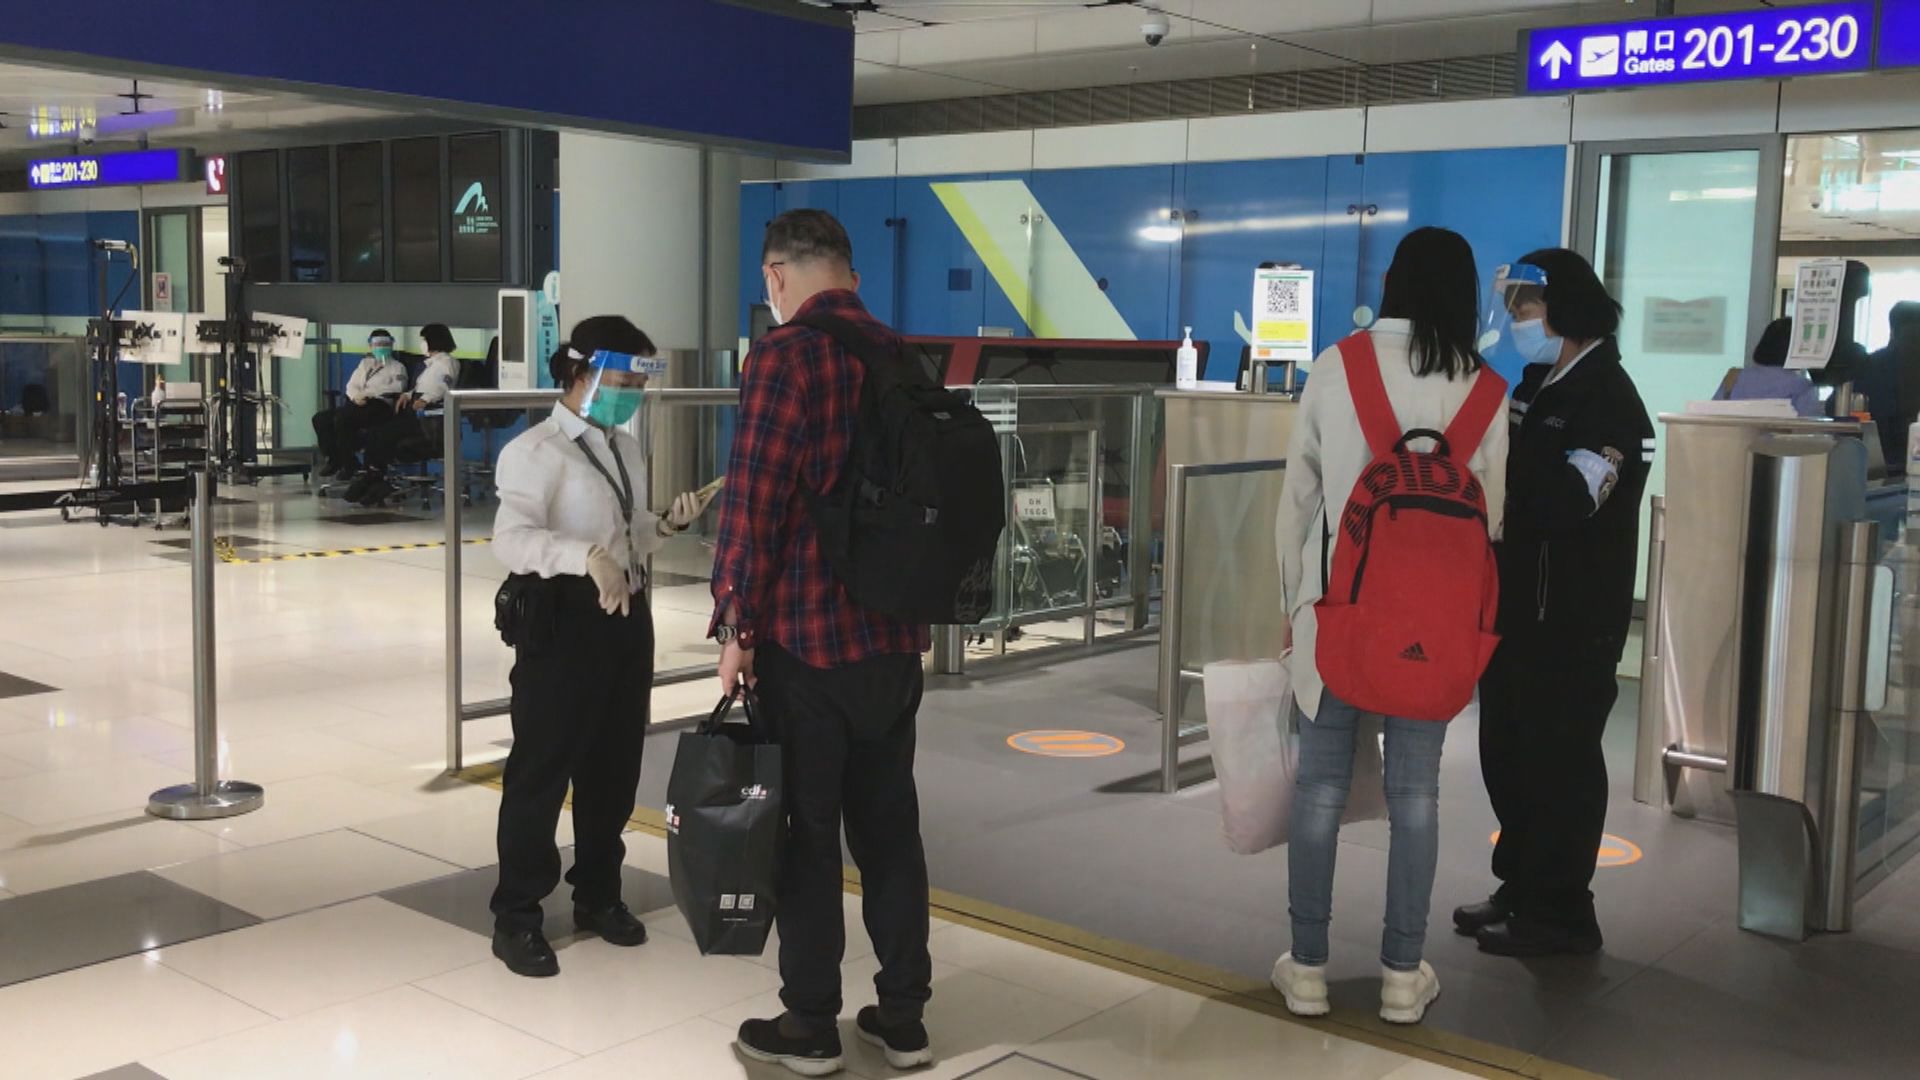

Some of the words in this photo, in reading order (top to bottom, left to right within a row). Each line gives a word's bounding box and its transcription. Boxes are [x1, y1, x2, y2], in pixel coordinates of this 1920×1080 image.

[1682, 15, 1858, 69] 201-230
[1625, 57, 1675, 74] Gates
[62, 160, 98, 181] 201-230
